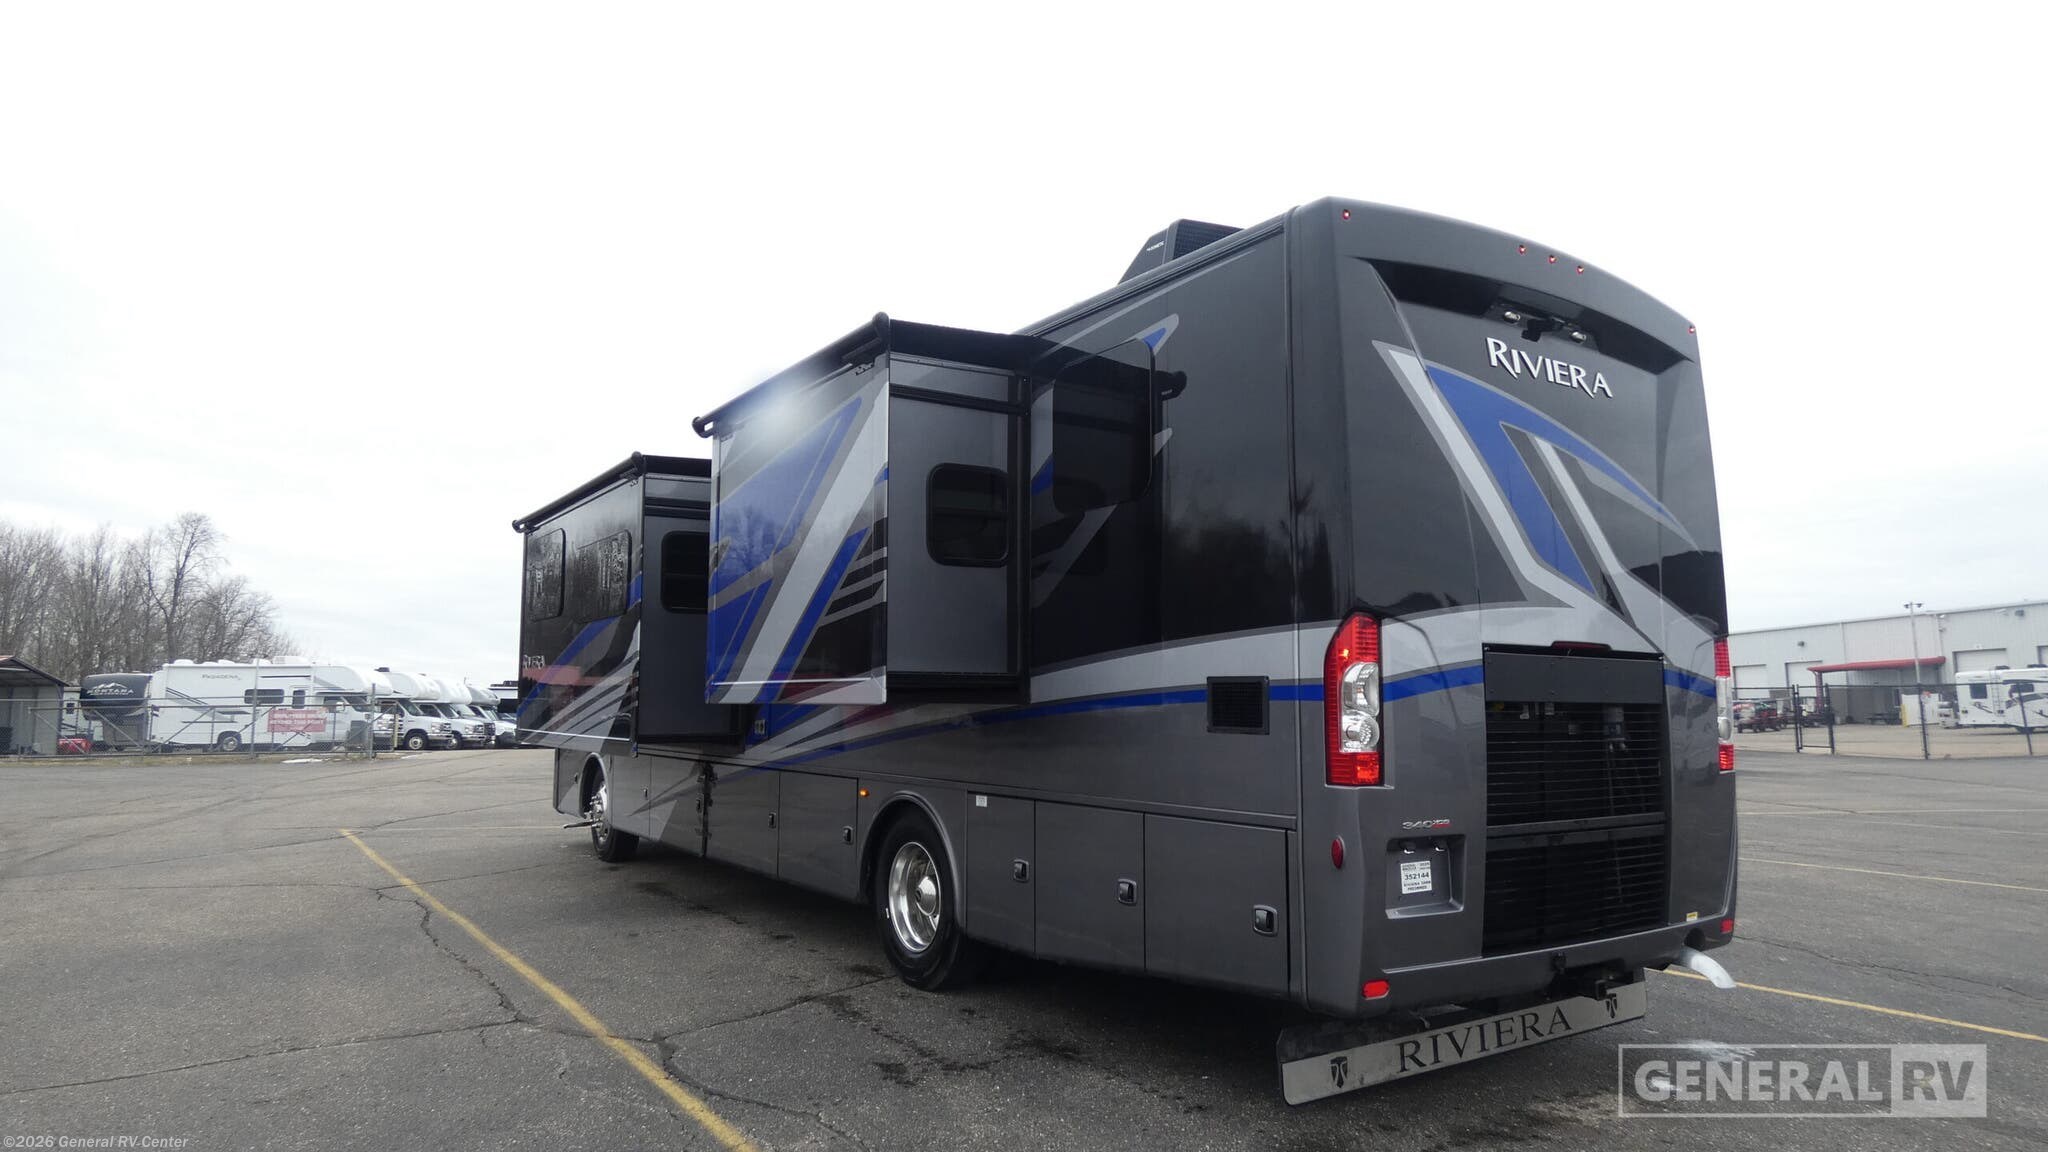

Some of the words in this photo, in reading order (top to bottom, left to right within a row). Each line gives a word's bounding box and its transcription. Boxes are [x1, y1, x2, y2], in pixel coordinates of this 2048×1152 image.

[1486, 337, 1613, 399] RIVIERA
[1404, 872, 1429, 881] 352144
[1398, 1005, 1572, 1075] RIVIERA
